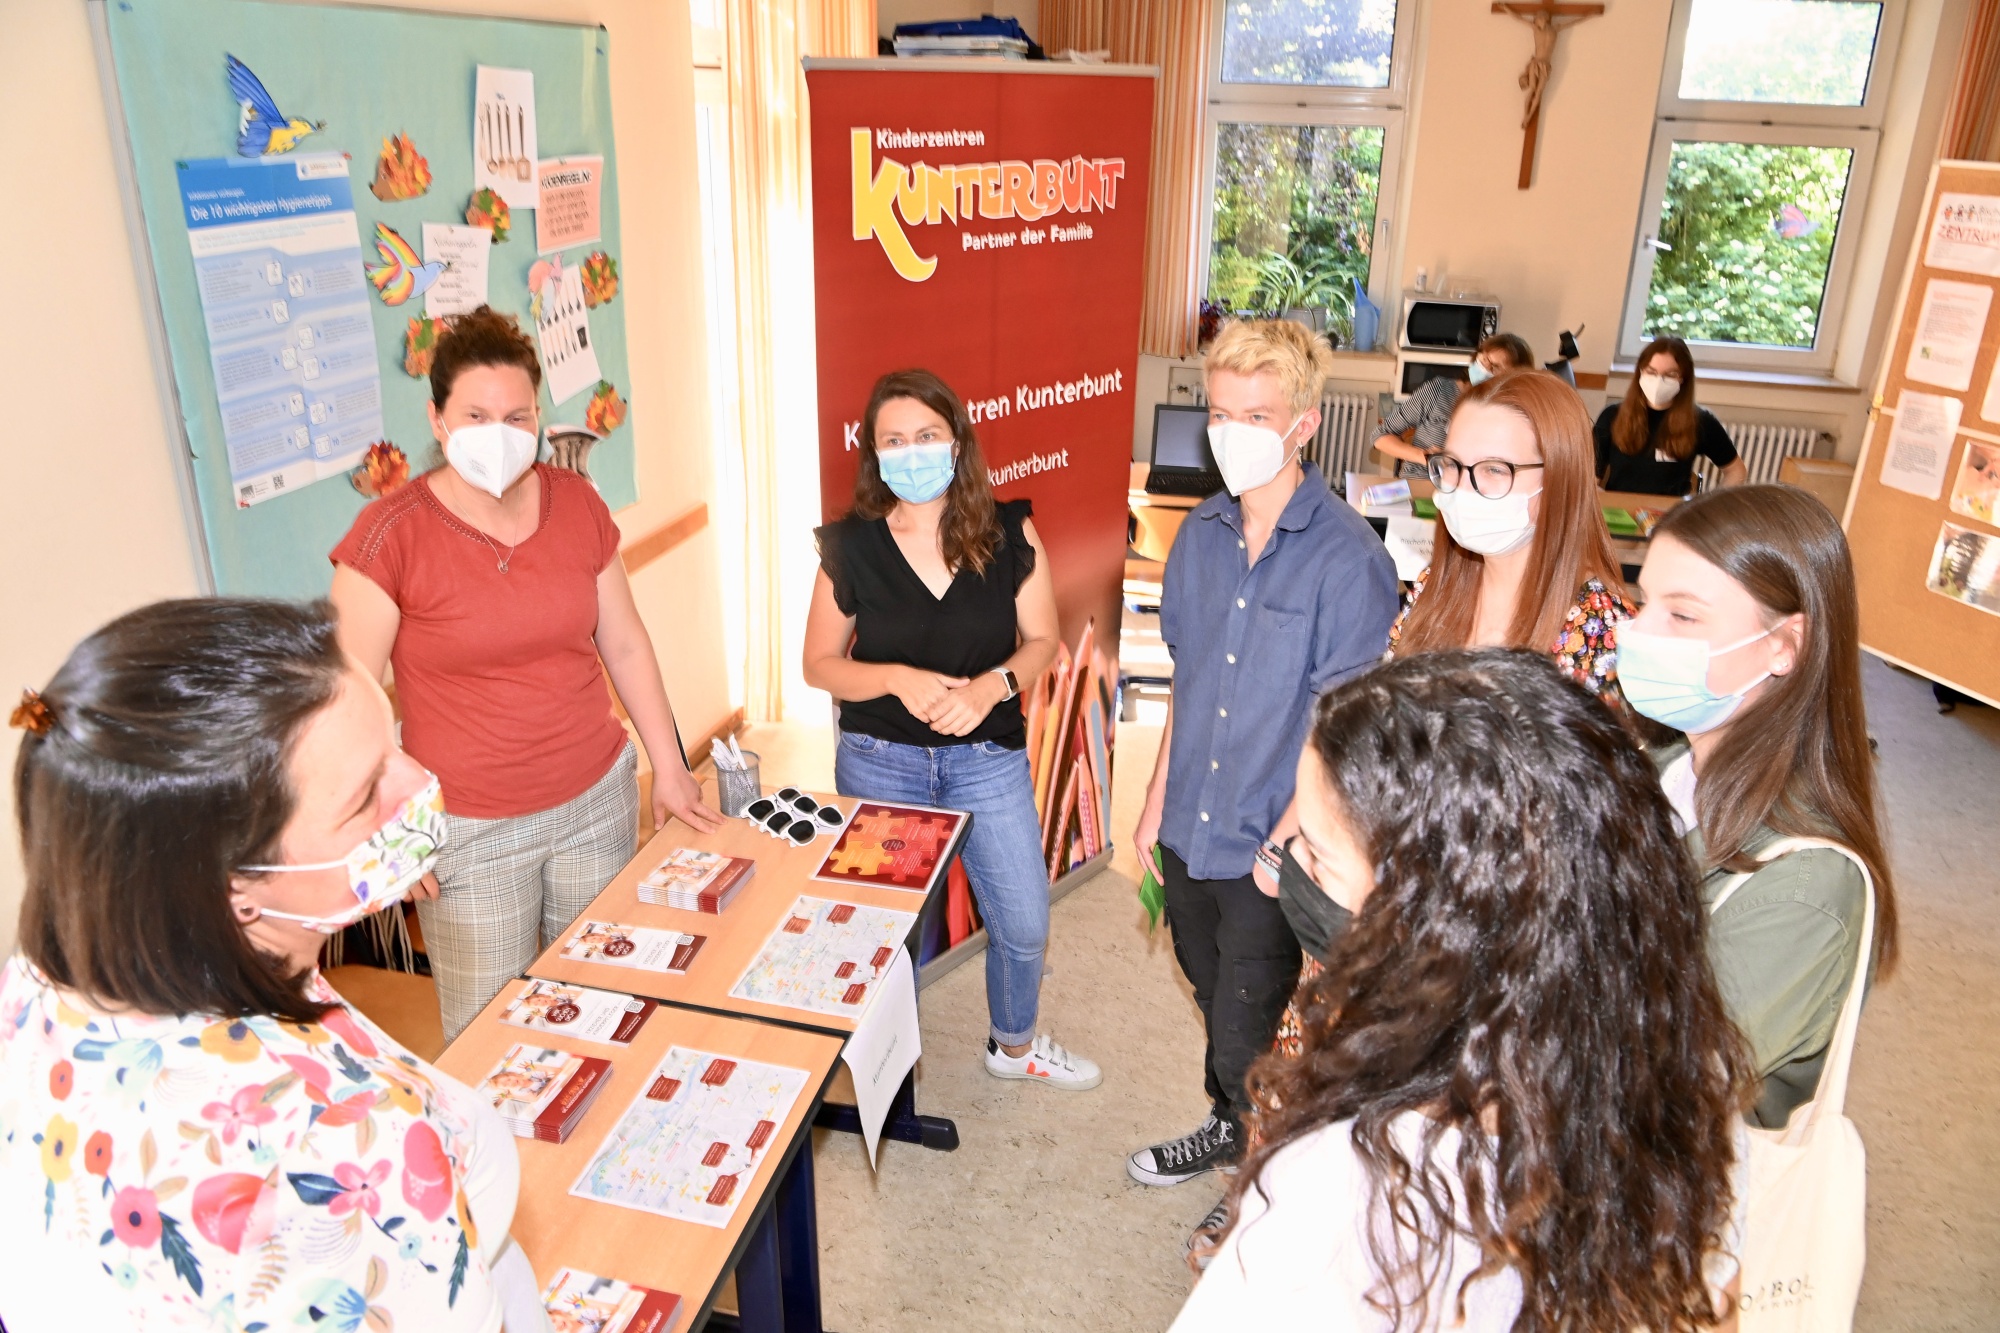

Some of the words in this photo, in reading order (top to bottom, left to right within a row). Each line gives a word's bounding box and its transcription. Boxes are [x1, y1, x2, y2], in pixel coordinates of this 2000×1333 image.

[876, 128, 985, 149] Kinderzentren
[190, 203, 209, 221] Die
[209, 202, 223, 219] 10
[223, 199, 278, 217] wichtigsten
[277, 193, 333, 213] Hygienetipps
[851, 127, 1125, 282] KUNTERBUNT
[962, 230, 1017, 251] Partner
[1021, 226, 1046, 245] der
[1050, 221, 1094, 243] Familie
[1016, 367, 1122, 412] Kunterbunt
[987, 447, 1068, 487] kunterbunt
